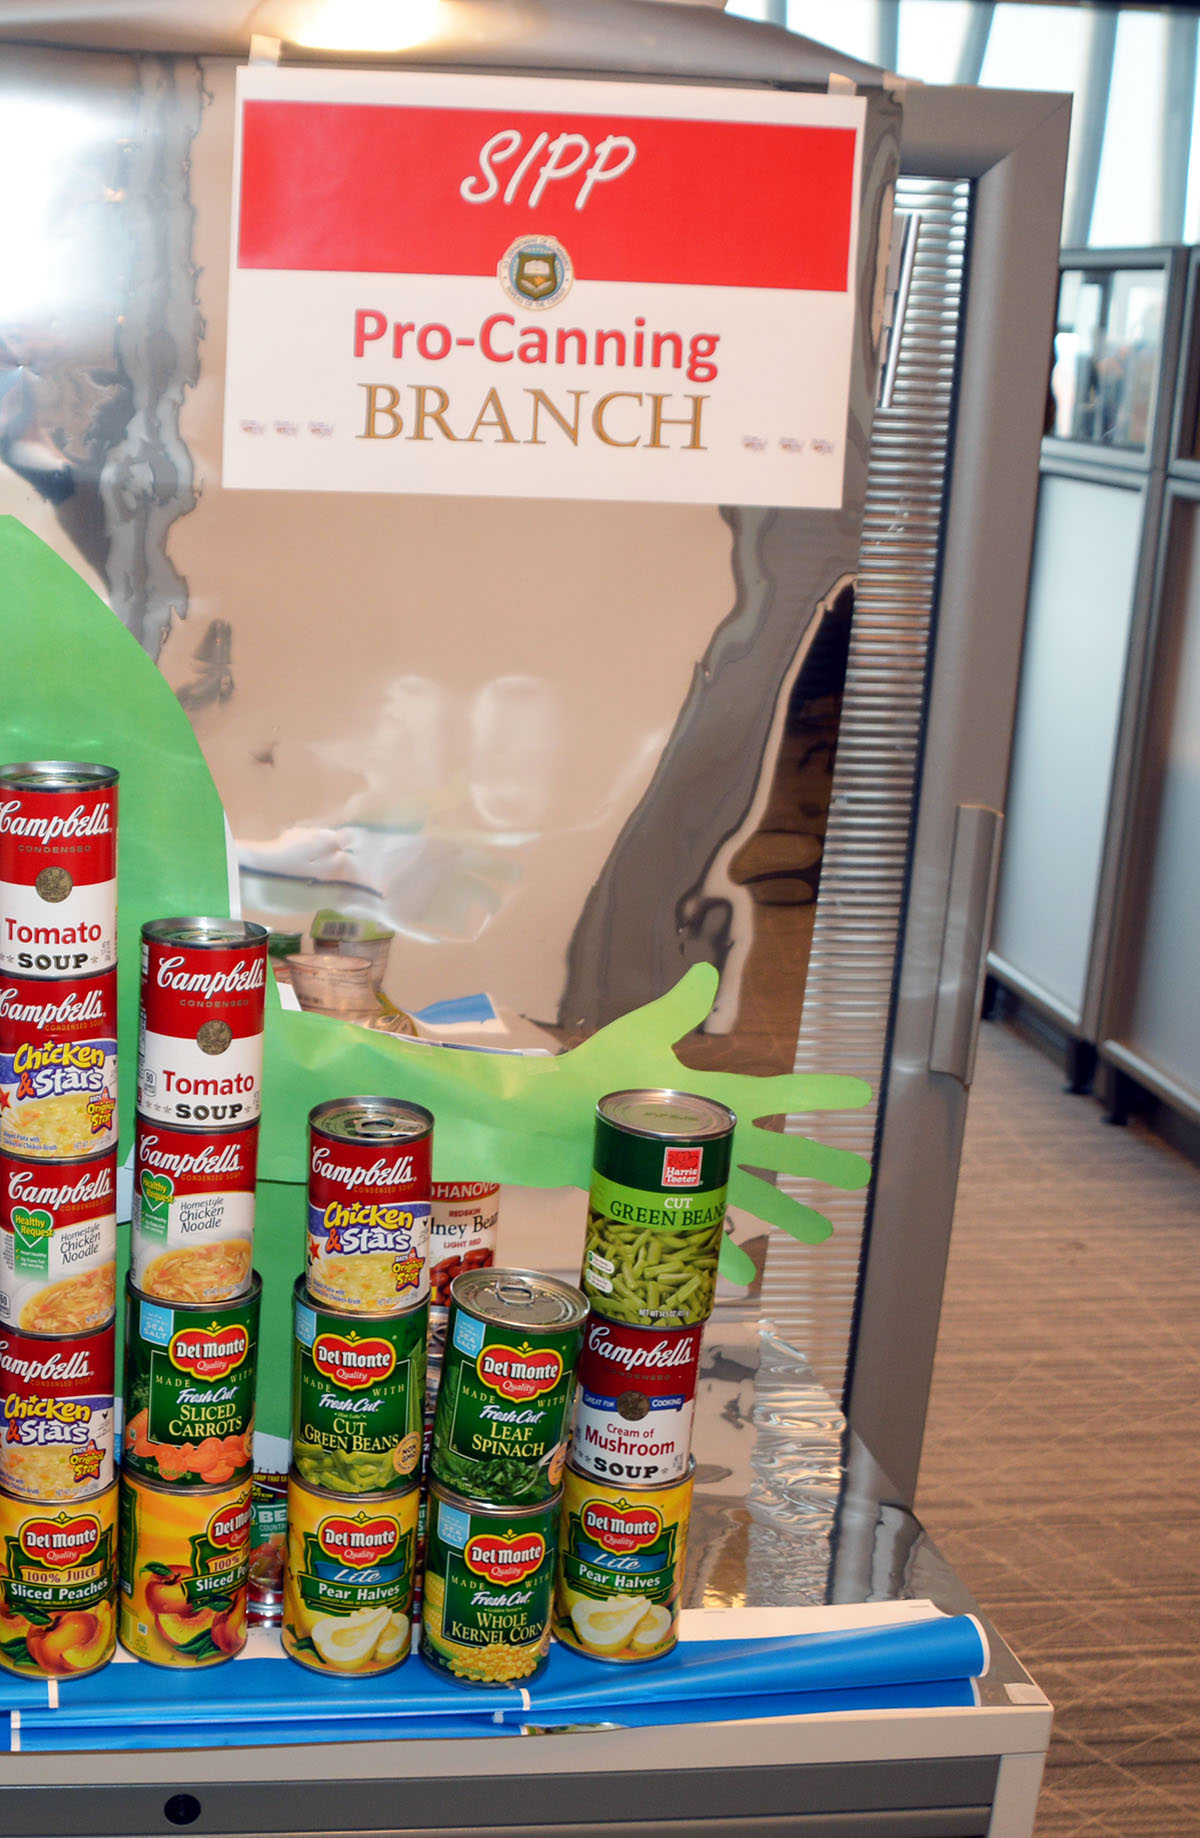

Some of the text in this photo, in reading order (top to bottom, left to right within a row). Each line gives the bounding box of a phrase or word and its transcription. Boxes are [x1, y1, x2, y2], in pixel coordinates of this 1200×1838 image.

[459, 129, 636, 211] SIPP
[353, 308, 721, 383] Pro-Canning
[356, 382, 711, 450] BRANCH
[5, 918, 101, 944] Tomato
[18, 953, 89, 970] SOUP
[157, 956, 264, 999] Campbell's
[13, 1040, 105, 1074] Chicken
[17, 1067, 104, 1100] & Stars
[163, 1070, 254, 1096] Tomato
[176, 1103, 243, 1120] SOUP
[140, 1135, 241, 1177] Campbell's
[312, 1146, 414, 1190] Campbell's
[666, 1168, 697, 1176] Harris
[666, 1175, 697, 1183] Teeter
[8, 1167, 112, 1210] Campbell's
[610, 1200, 677, 1226] GREEN
[664, 1198, 693, 1209] CUT
[15, 1215, 45, 1228] Healthy
[21, 1226, 53, 1237] Request
[589, 1324, 693, 1371] Campbell's
[4, 1393, 91, 1422] Chicken
[180, 1403, 236, 1421] SLICED
[6, 1419, 89, 1444] & Stars
[169, 1417, 242, 1437] CARROTS
[304, 1424, 398, 1451] GREEN BEANS
[333, 1418, 367, 1435] CUT
[491, 1422, 533, 1441] LEAF
[472, 1435, 544, 1457] SPINACH
[215, 1523, 233, 1536] Del
[593, 1554, 640, 1570] Lite
[27, 1566, 96, 1582] 100% JUICE
[196, 1574, 233, 1591] Sliced
[334, 1568, 381, 1583] Lite
[452, 1576, 485, 1591] MADE
[579, 1563, 609, 1584] Pear
[615, 1574, 660, 1588] Halves
[11, 1578, 108, 1600] Sliced Peaches
[319, 1583, 351, 1599] Pear
[357, 1584, 400, 1601] Halves
[477, 1612, 527, 1629] WHOLE
[452, 1621, 506, 1644] KERNEL
